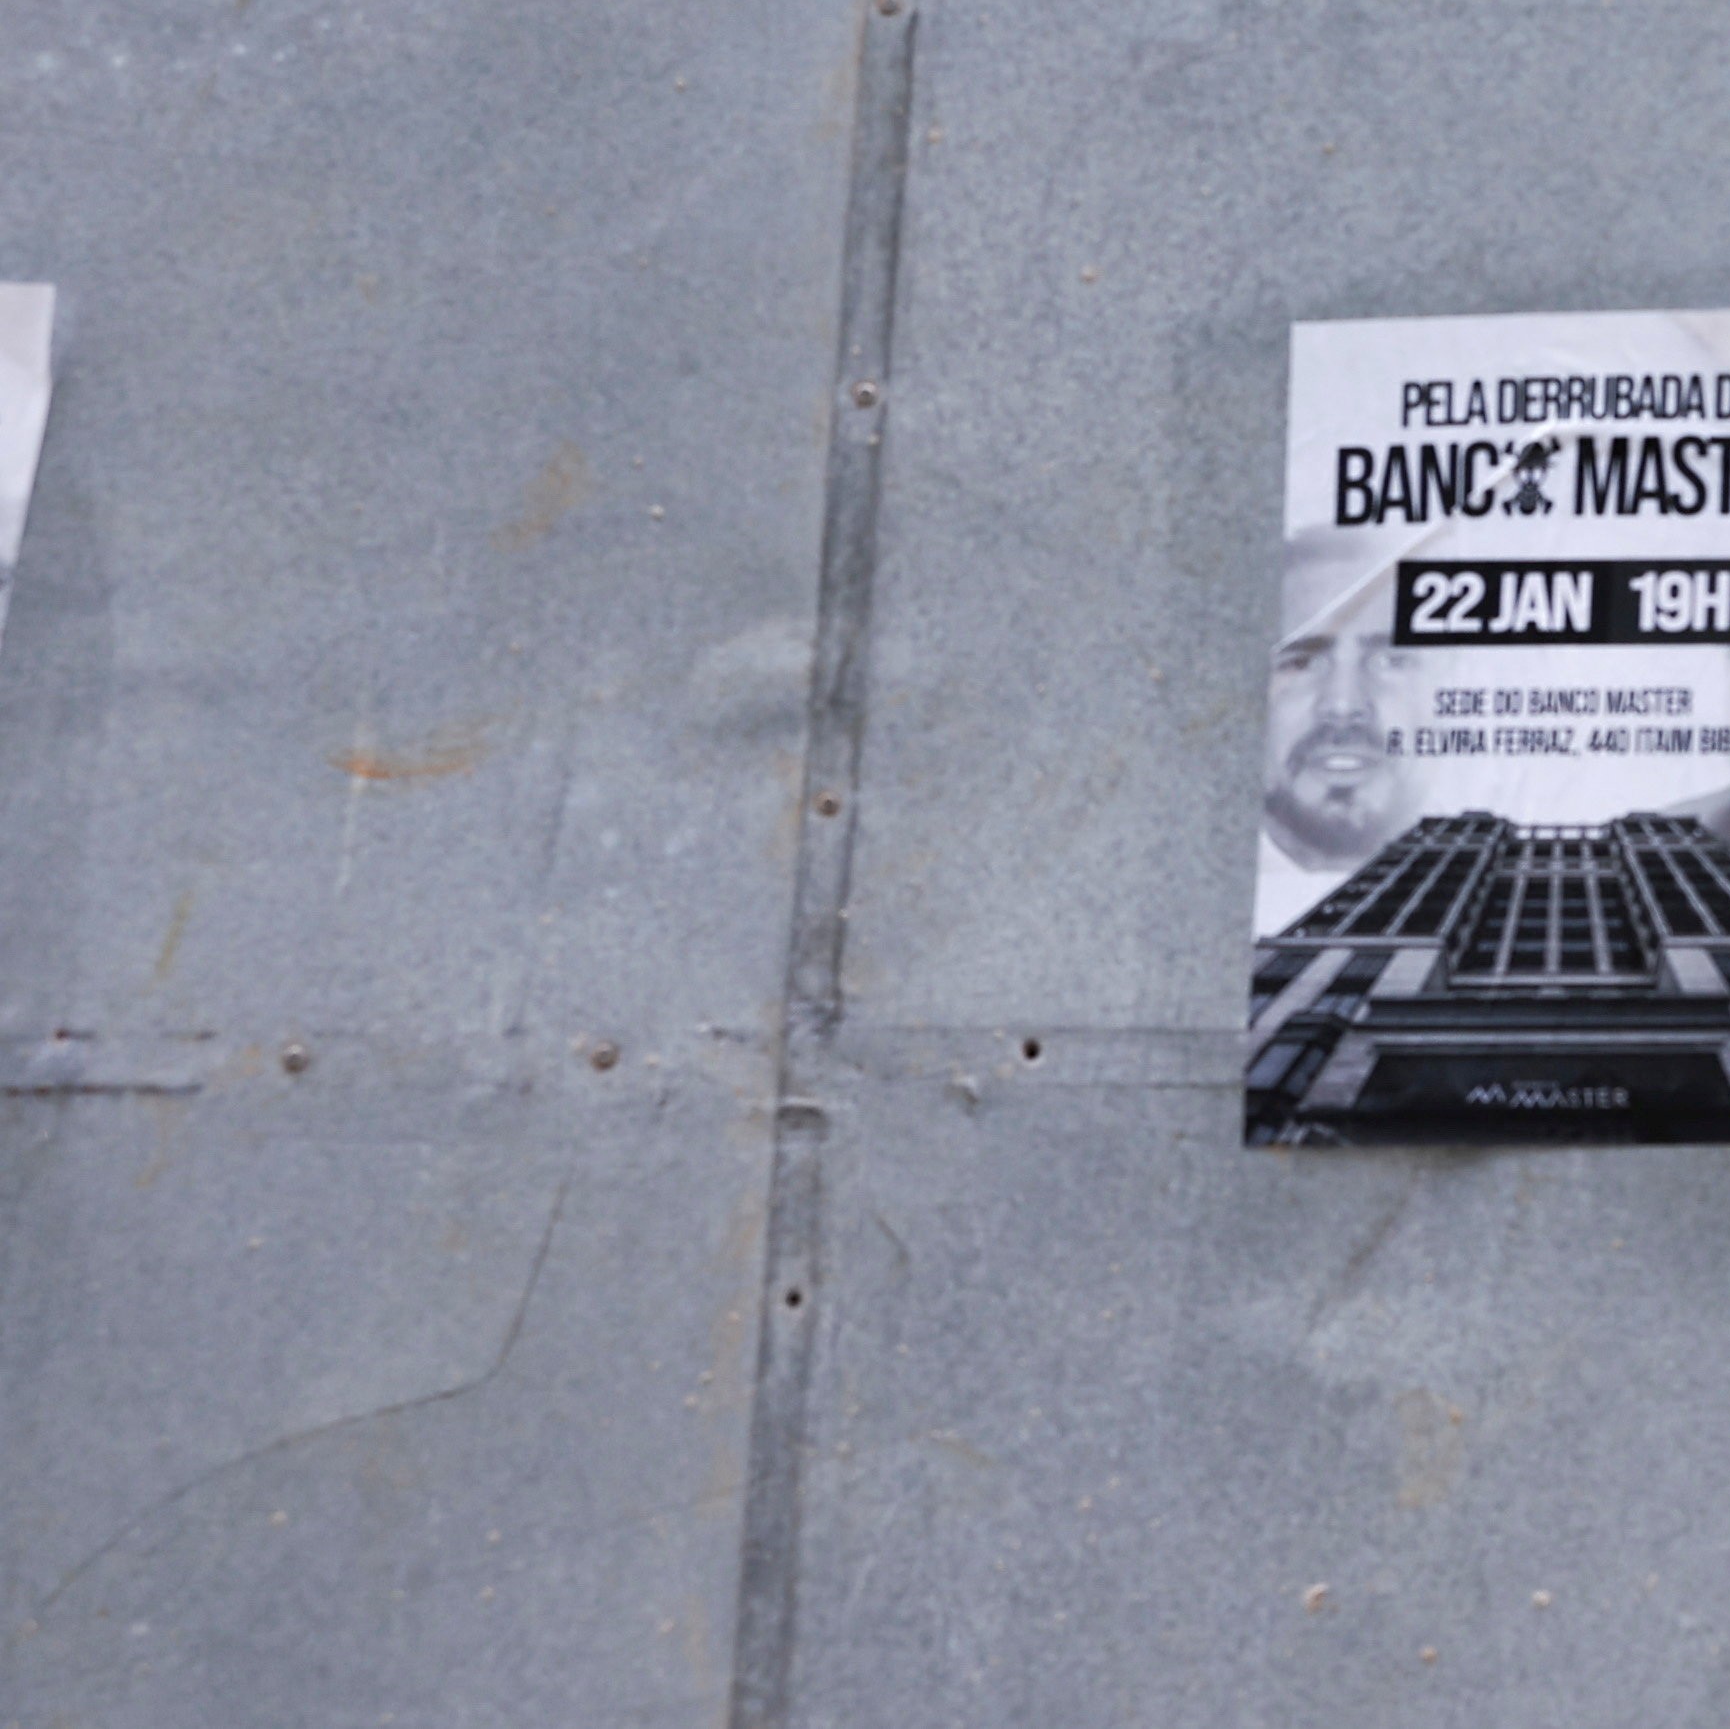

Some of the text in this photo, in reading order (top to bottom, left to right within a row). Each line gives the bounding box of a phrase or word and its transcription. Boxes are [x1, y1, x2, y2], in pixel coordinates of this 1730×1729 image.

[1402, 380, 1486, 427] PELA
[1498, 374, 1706, 424] DERRUBADA
[1410, 572, 1485, 633] 22
[1488, 572, 1592, 632] JAN
[1435, 688, 1485, 716] SEDE
[1528, 688, 1599, 715] BANCO
[1606, 688, 1692, 714] MASTER
